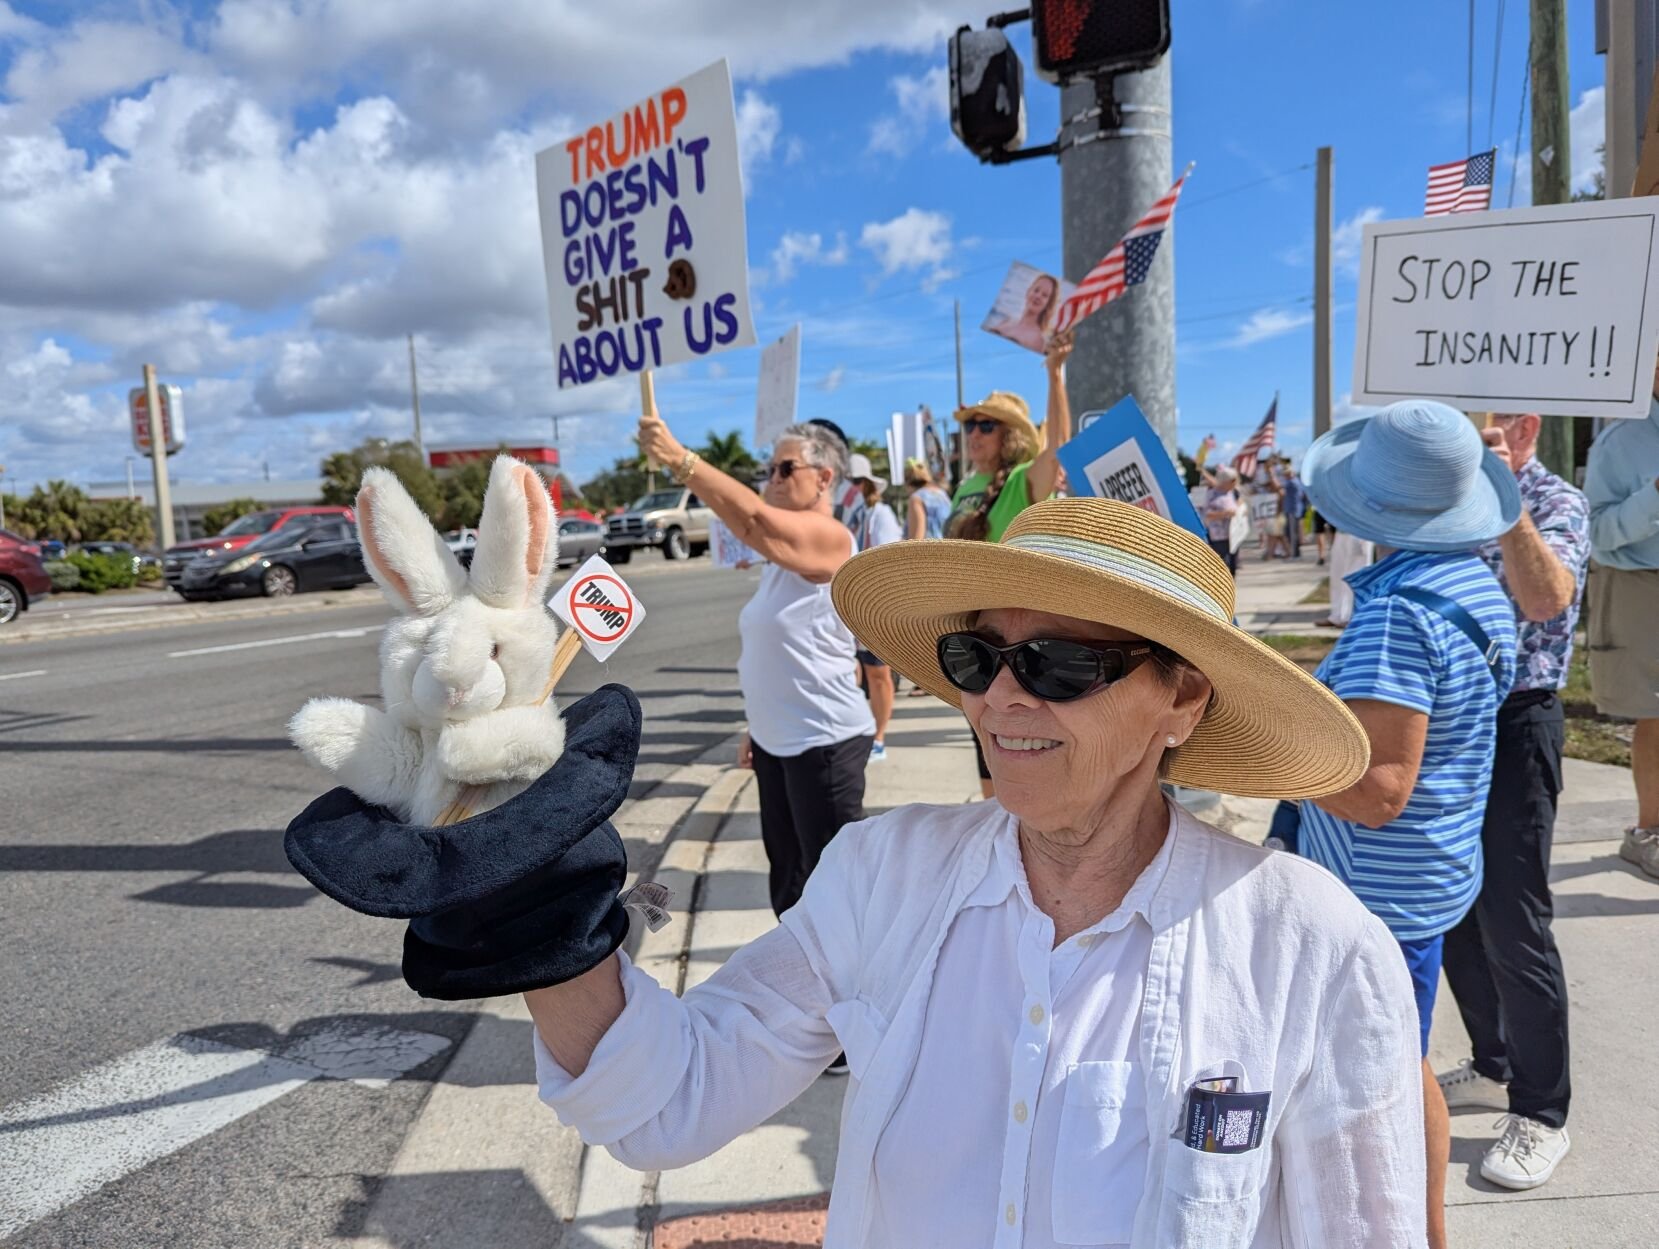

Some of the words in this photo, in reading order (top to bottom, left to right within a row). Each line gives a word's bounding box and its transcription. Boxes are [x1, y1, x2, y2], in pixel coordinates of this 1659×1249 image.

[566, 87, 687, 185] TRUMP
[560, 137, 710, 238] DOESN'T
[564, 221, 639, 286] GIVE
[665, 203, 693, 259] A
[576, 268, 650, 332] SHIT
[1392, 255, 1491, 303] STOP
[1511, 260, 1580, 298] THE
[558, 316, 663, 388] ABOUT
[684, 292, 739, 354] US
[1415, 325, 1615, 377] INSANITY!!
[580, 581, 625, 630] TRUMP
[1192, 1103, 1201, 1134] Educated
